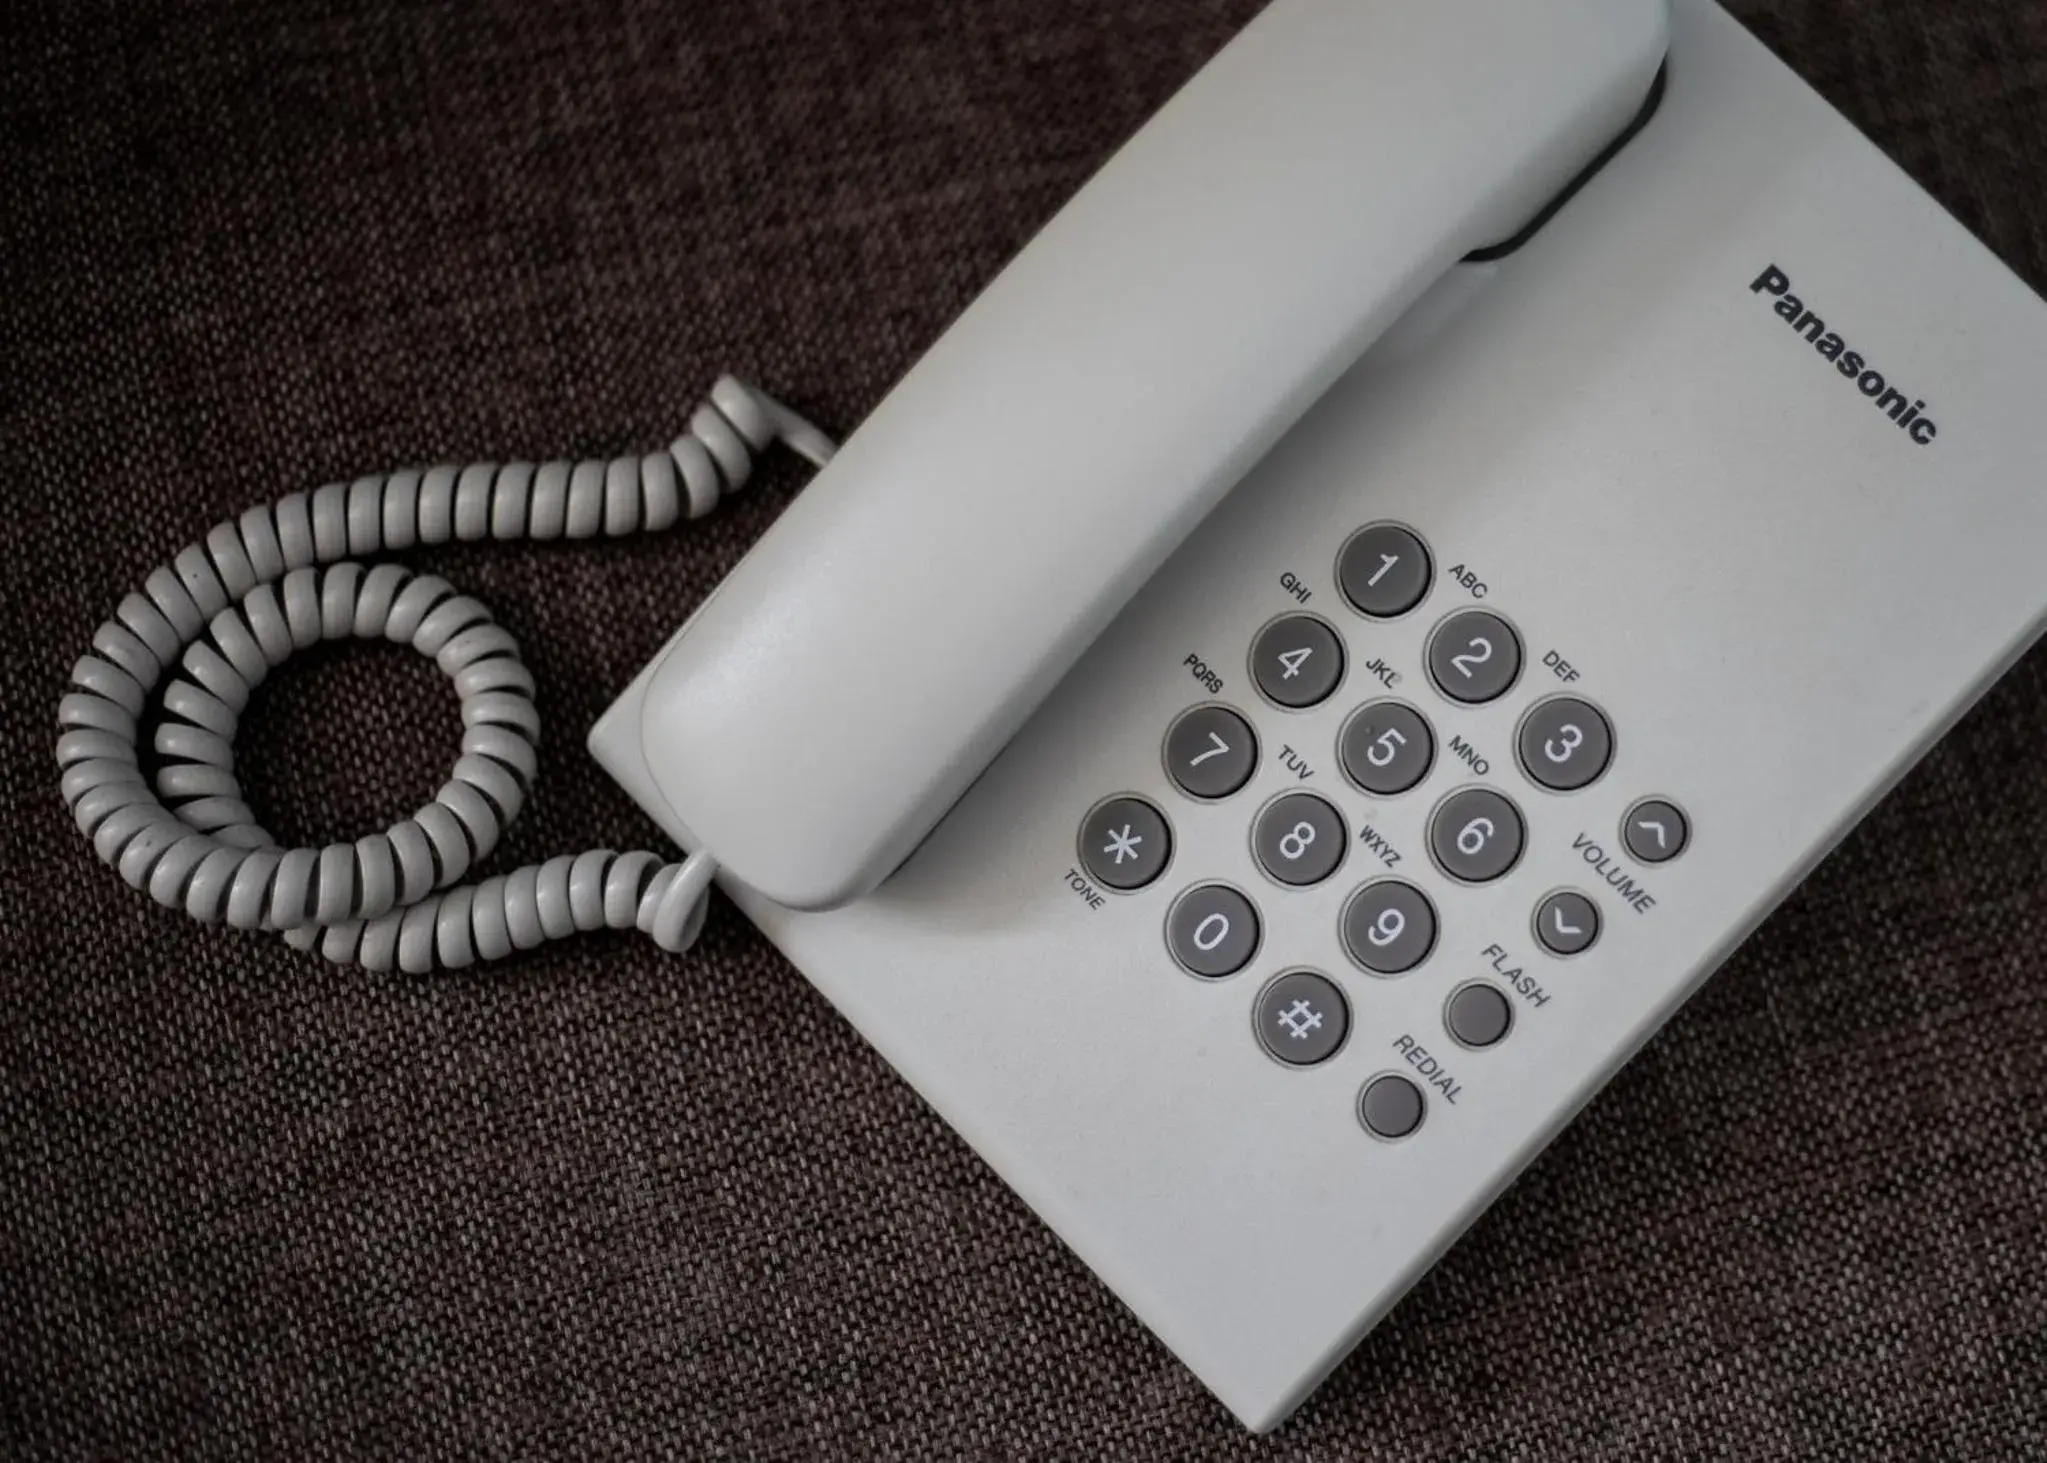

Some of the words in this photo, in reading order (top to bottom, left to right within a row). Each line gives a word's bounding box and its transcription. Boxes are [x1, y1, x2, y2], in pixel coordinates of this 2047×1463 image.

[1749, 263, 1937, 445] Panasonic
[1279, 571, 1312, 604] GHI
[1367, 553, 1399, 587] 1
[1447, 563, 1488, 599] ABC
[1182, 652, 1224, 694] PQRS
[1278, 647, 1313, 680] 4
[1365, 658, 1397, 689] JKL
[1451, 637, 1492, 678] 2
[1541, 649, 1581, 683] DEF
[1190, 731, 1230, 767] 7
[1278, 744, 1315, 781] TUV
[1367, 727, 1407, 767] 5
[1448, 734, 1490, 776] MNO
[1544, 724, 1583, 763] 3
[1279, 821, 1316, 860] 8
[1359, 824, 1402, 868] WXYZ
[1457, 817, 1495, 855] 6
[1064, 868, 1106, 910] TONE
[1571, 832, 1657, 914] VOLUME
[1193, 913, 1230, 951] 0
[1368, 908, 1405, 947] 9
[1481, 943, 1551, 1008] FLASH
[1277, 999, 1323, 1040] #
[1392, 1034, 1462, 1105] REDIAL
